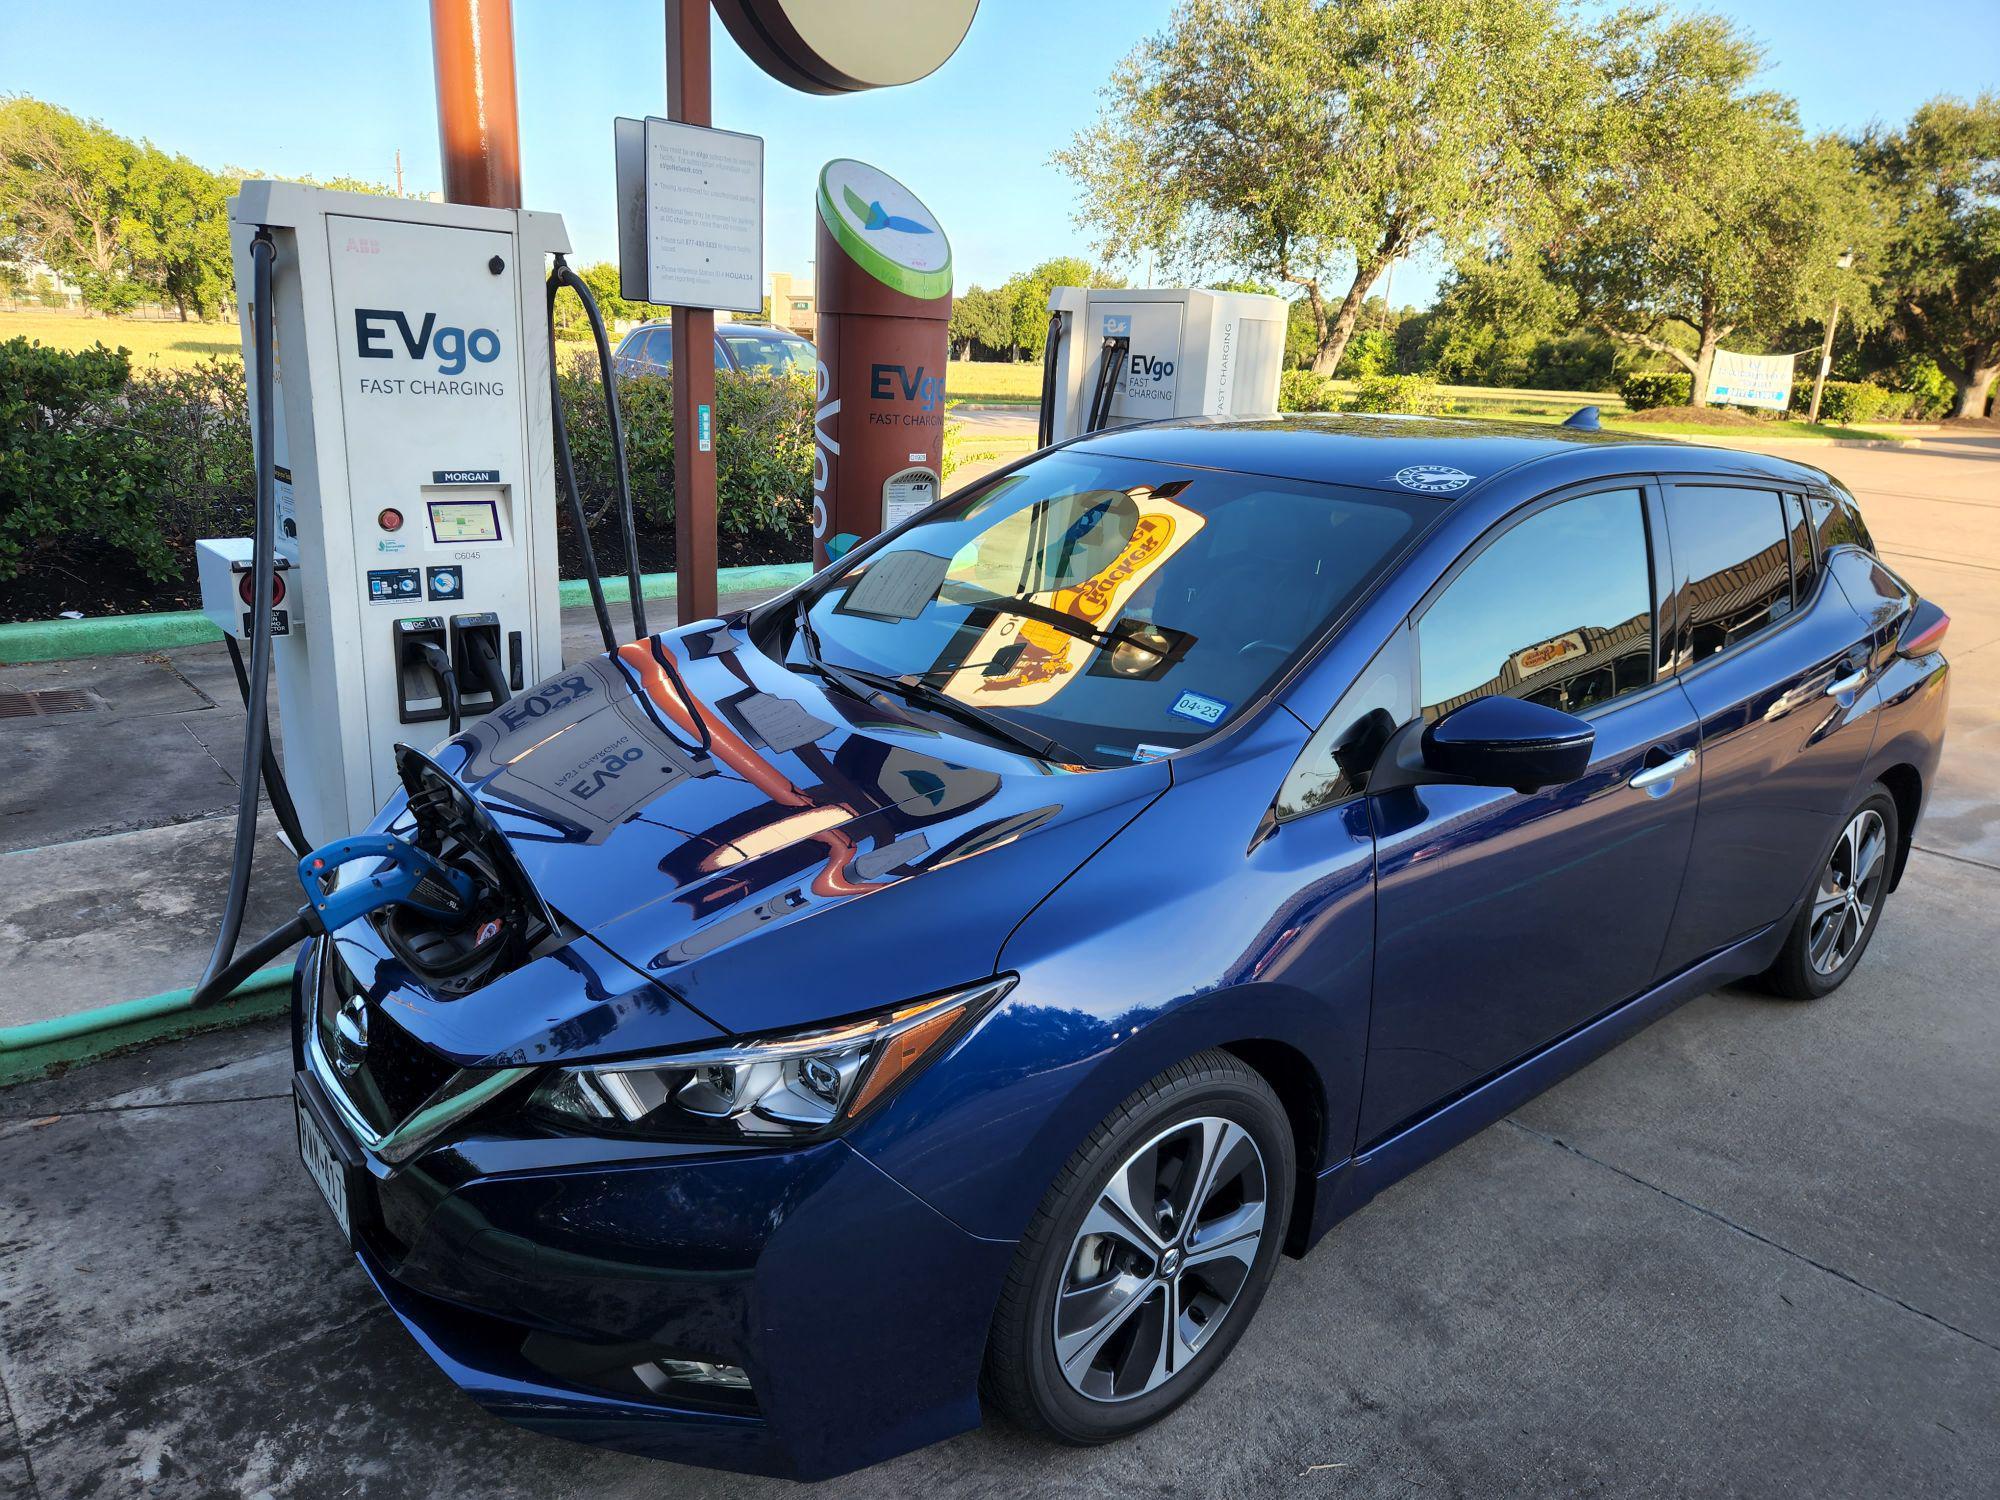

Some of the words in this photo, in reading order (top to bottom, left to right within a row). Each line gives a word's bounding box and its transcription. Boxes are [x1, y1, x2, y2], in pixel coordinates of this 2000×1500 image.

[354, 308, 501, 375] EVgo
[1220, 323, 1232, 386] CHARGING
[1131, 355, 1174, 382] EVgo
[360, 379, 405, 394] FAST
[410, 380, 504, 396] CHARGING
[1129, 378, 1150, 388] FAST
[1128, 389, 1172, 401] CHARGING
[869, 413, 900, 425] FAST
[445, 472, 487, 481] MORGAN
[1402, 480, 1464, 491] EXPRESS
[1179, 699, 1198, 712] 04
[1201, 706, 1220, 719] 23
